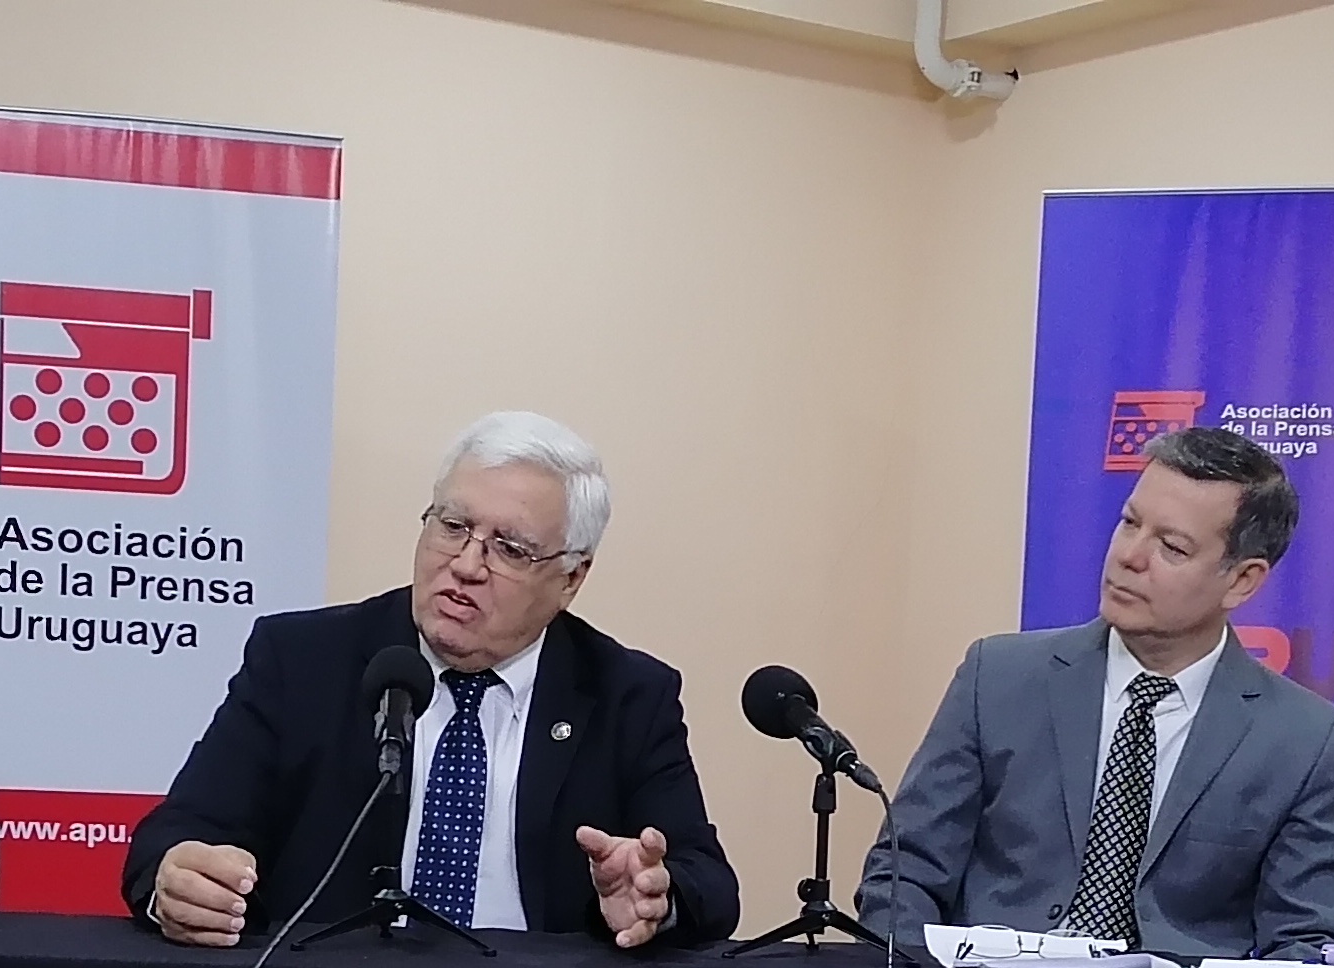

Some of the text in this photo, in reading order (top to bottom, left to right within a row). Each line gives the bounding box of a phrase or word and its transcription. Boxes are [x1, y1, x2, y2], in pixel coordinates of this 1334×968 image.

[1220, 403, 1333, 419] Asociación
[1251, 421, 1268, 436] la
[1258, 441, 1318, 458] uaya
[60, 562, 93, 597] la
[110, 565, 254, 605] Prensa
